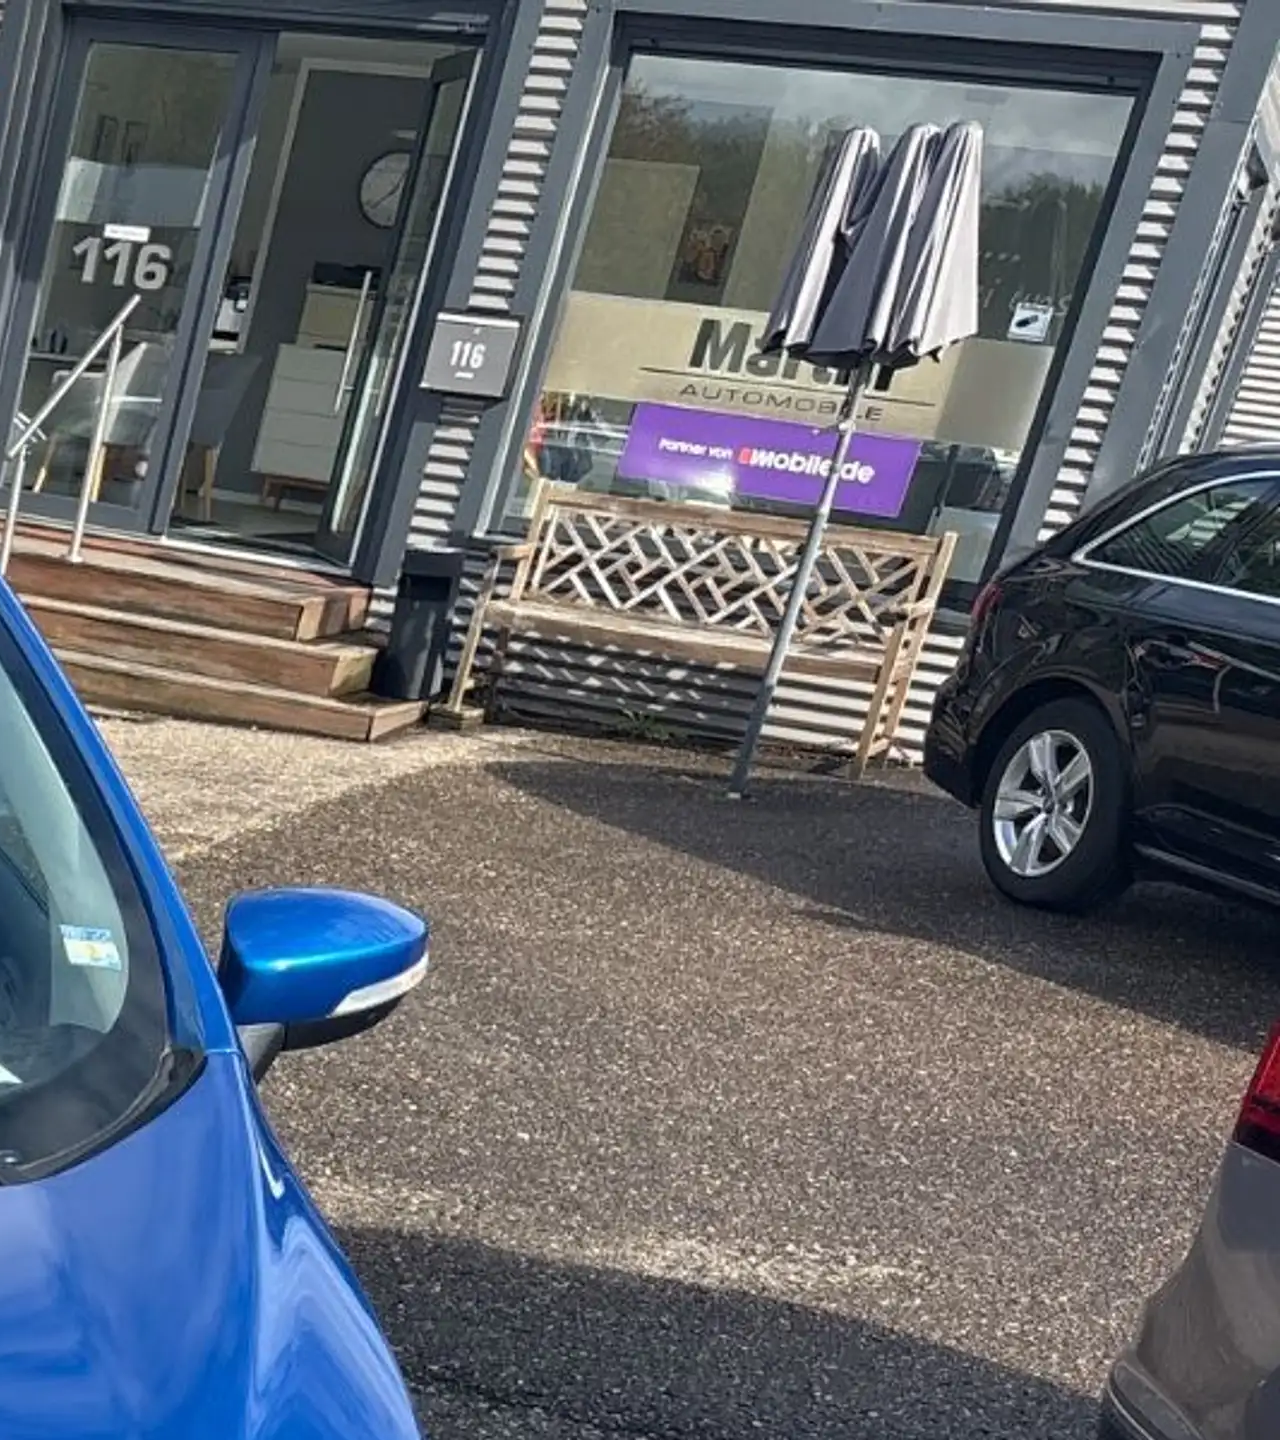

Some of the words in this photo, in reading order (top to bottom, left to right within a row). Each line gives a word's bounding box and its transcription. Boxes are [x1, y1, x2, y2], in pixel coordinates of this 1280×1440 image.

[72, 236, 172, 290] 116
[450, 340, 485, 368] 116
[679, 384, 884, 421] AUTOMOBE
[658, 438, 707, 456] Partner
[709, 446, 733, 460] von
[740, 447, 875, 484] mobilede
